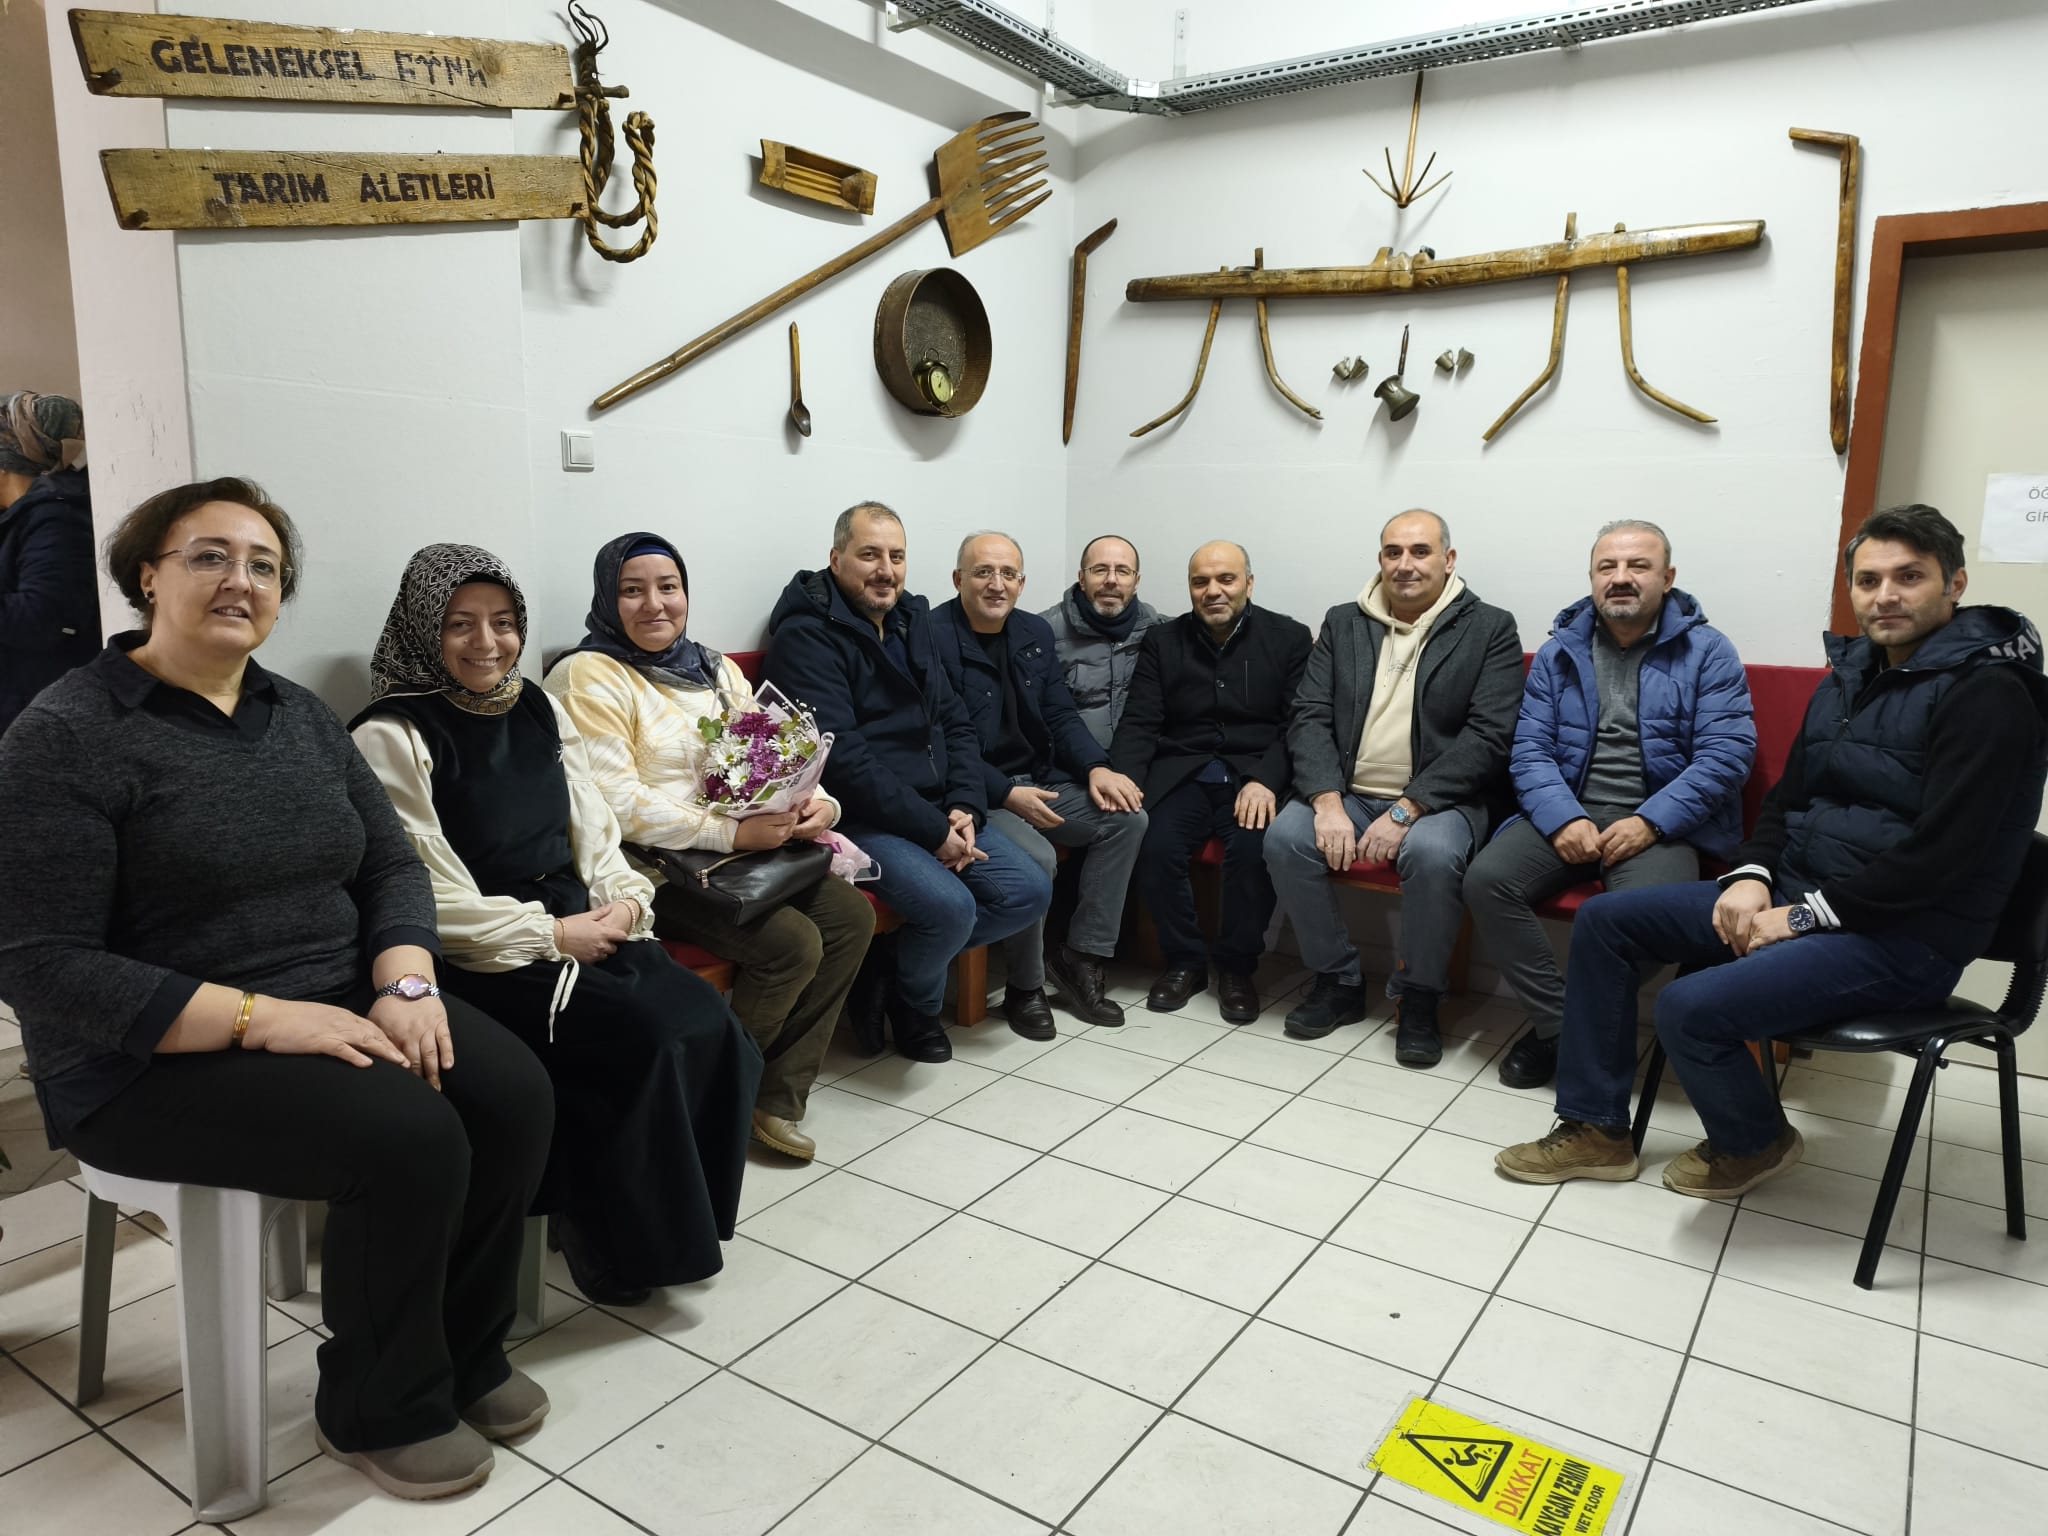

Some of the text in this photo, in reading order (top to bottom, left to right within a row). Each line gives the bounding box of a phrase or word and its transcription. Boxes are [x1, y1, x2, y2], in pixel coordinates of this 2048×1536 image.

[151, 39, 377, 81] GELENEKSEL
[212, 166, 496, 205] TARIM ALETLERİ
[1494, 1447, 1544, 1517] DİKKAT
[1574, 1484, 1606, 1534] WET FLOOR
